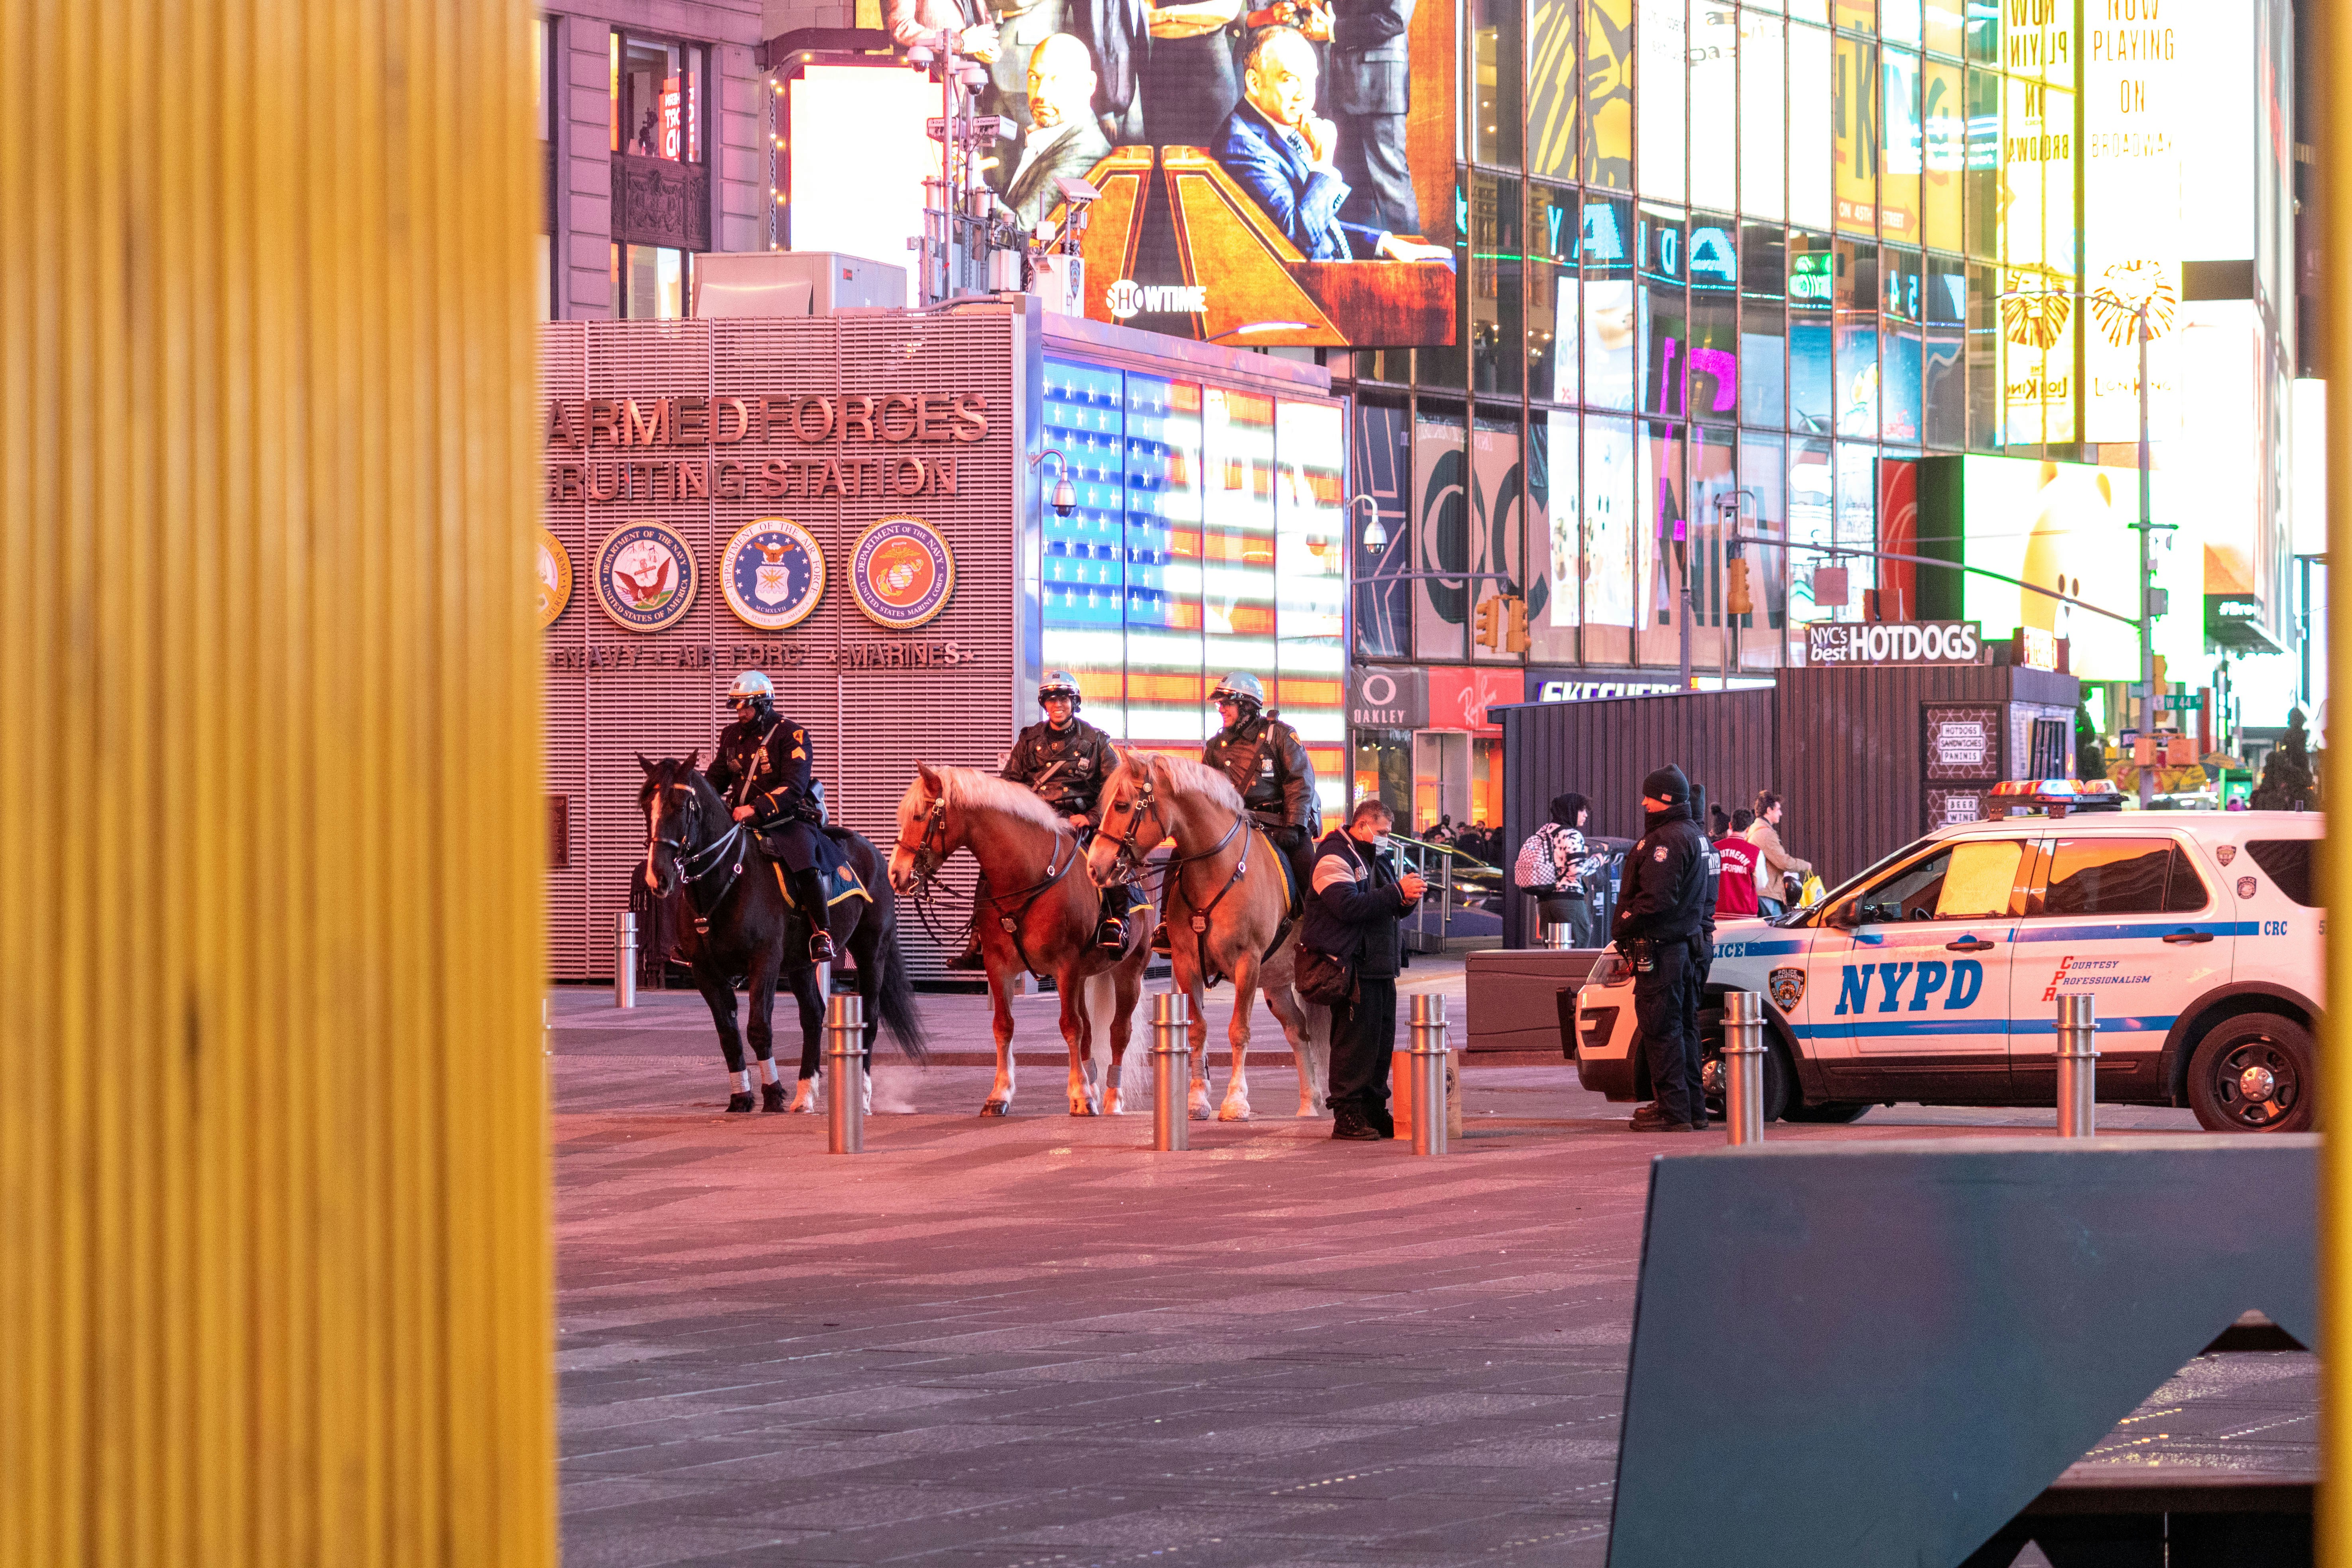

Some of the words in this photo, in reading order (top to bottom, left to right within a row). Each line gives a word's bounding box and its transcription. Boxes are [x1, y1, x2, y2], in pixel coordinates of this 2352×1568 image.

[2108, 0, 2158, 20] NOW
[2094, 28, 2173, 61] PLAYING
[2121, 80, 2144, 112] ON
[2092, 133, 2173, 157] BROADWAY
[1838, 201, 1852, 218] ON
[1854, 205, 1873, 222] 45TH
[1882, 210, 1904, 229] STREET
[1106, 279, 1207, 318] SHOWTIME
[2134, 377, 2171, 396] KNG
[545, 397, 748, 447] ARMED
[759, 392, 988, 442] FORCES
[557, 459, 746, 500] RUITING
[759, 457, 957, 497] STATION
[603, 531, 640, 574] DEPARTMENT
[658, 533, 673, 547] THE
[671, 544, 687, 565] NAVY
[724, 527, 754, 589] DEPARTMENT
[760, 522, 773, 531] OF
[779, 522, 800, 537] THE
[801, 537, 816, 555] AIR
[810, 560, 821, 595] FORCE
[858, 525, 900, 573] DEPARTMENT
[913, 528, 927, 540] THE
[927, 539, 945, 565] NAVY
[555, 551, 567, 576] ARMY
[545, 584, 567, 619] MERICA
[603, 584, 624, 613] UNITED
[623, 610, 652, 622] STATES
[654, 610, 665, 620] OF
[666, 578, 688, 614] AMERICA
[860, 581, 879, 608] UNITED
[879, 606, 905, 617] STATES
[907, 596, 934, 616] MARINE
[932, 573, 944, 597] CORPS
[732, 597, 749, 615] UNITED
[751, 613, 771, 624] STATES
[787, 602, 809, 620] AMERICA
[755, 605, 787, 614] MCMXLVII
[1811, 626, 1847, 645] NYC's
[1850, 624, 1977, 661] HOTDOGS
[562, 644, 643, 667] NAVY
[676, 644, 714, 667] AIR
[729, 643, 810, 667] FORC
[846, 642, 960, 665] MARINES
[1811, 644, 1848, 661] best
[2179, 697, 2191, 708] 44
[1354, 709, 1404, 724] OAKLEY
[1720, 848, 1751, 866] UTHERN
[1721, 863, 1747, 875] IFORNIA
[2264, 921, 2287, 935] CRC
[1713, 943, 1744, 958] ICE
[2060, 956, 2119, 969] COURTESY
[1771, 974, 1803, 983] DEPARTMENT
[1834, 960, 1983, 1015] NYPD
[2051, 971, 2151, 985] PROFESSIONALISM
